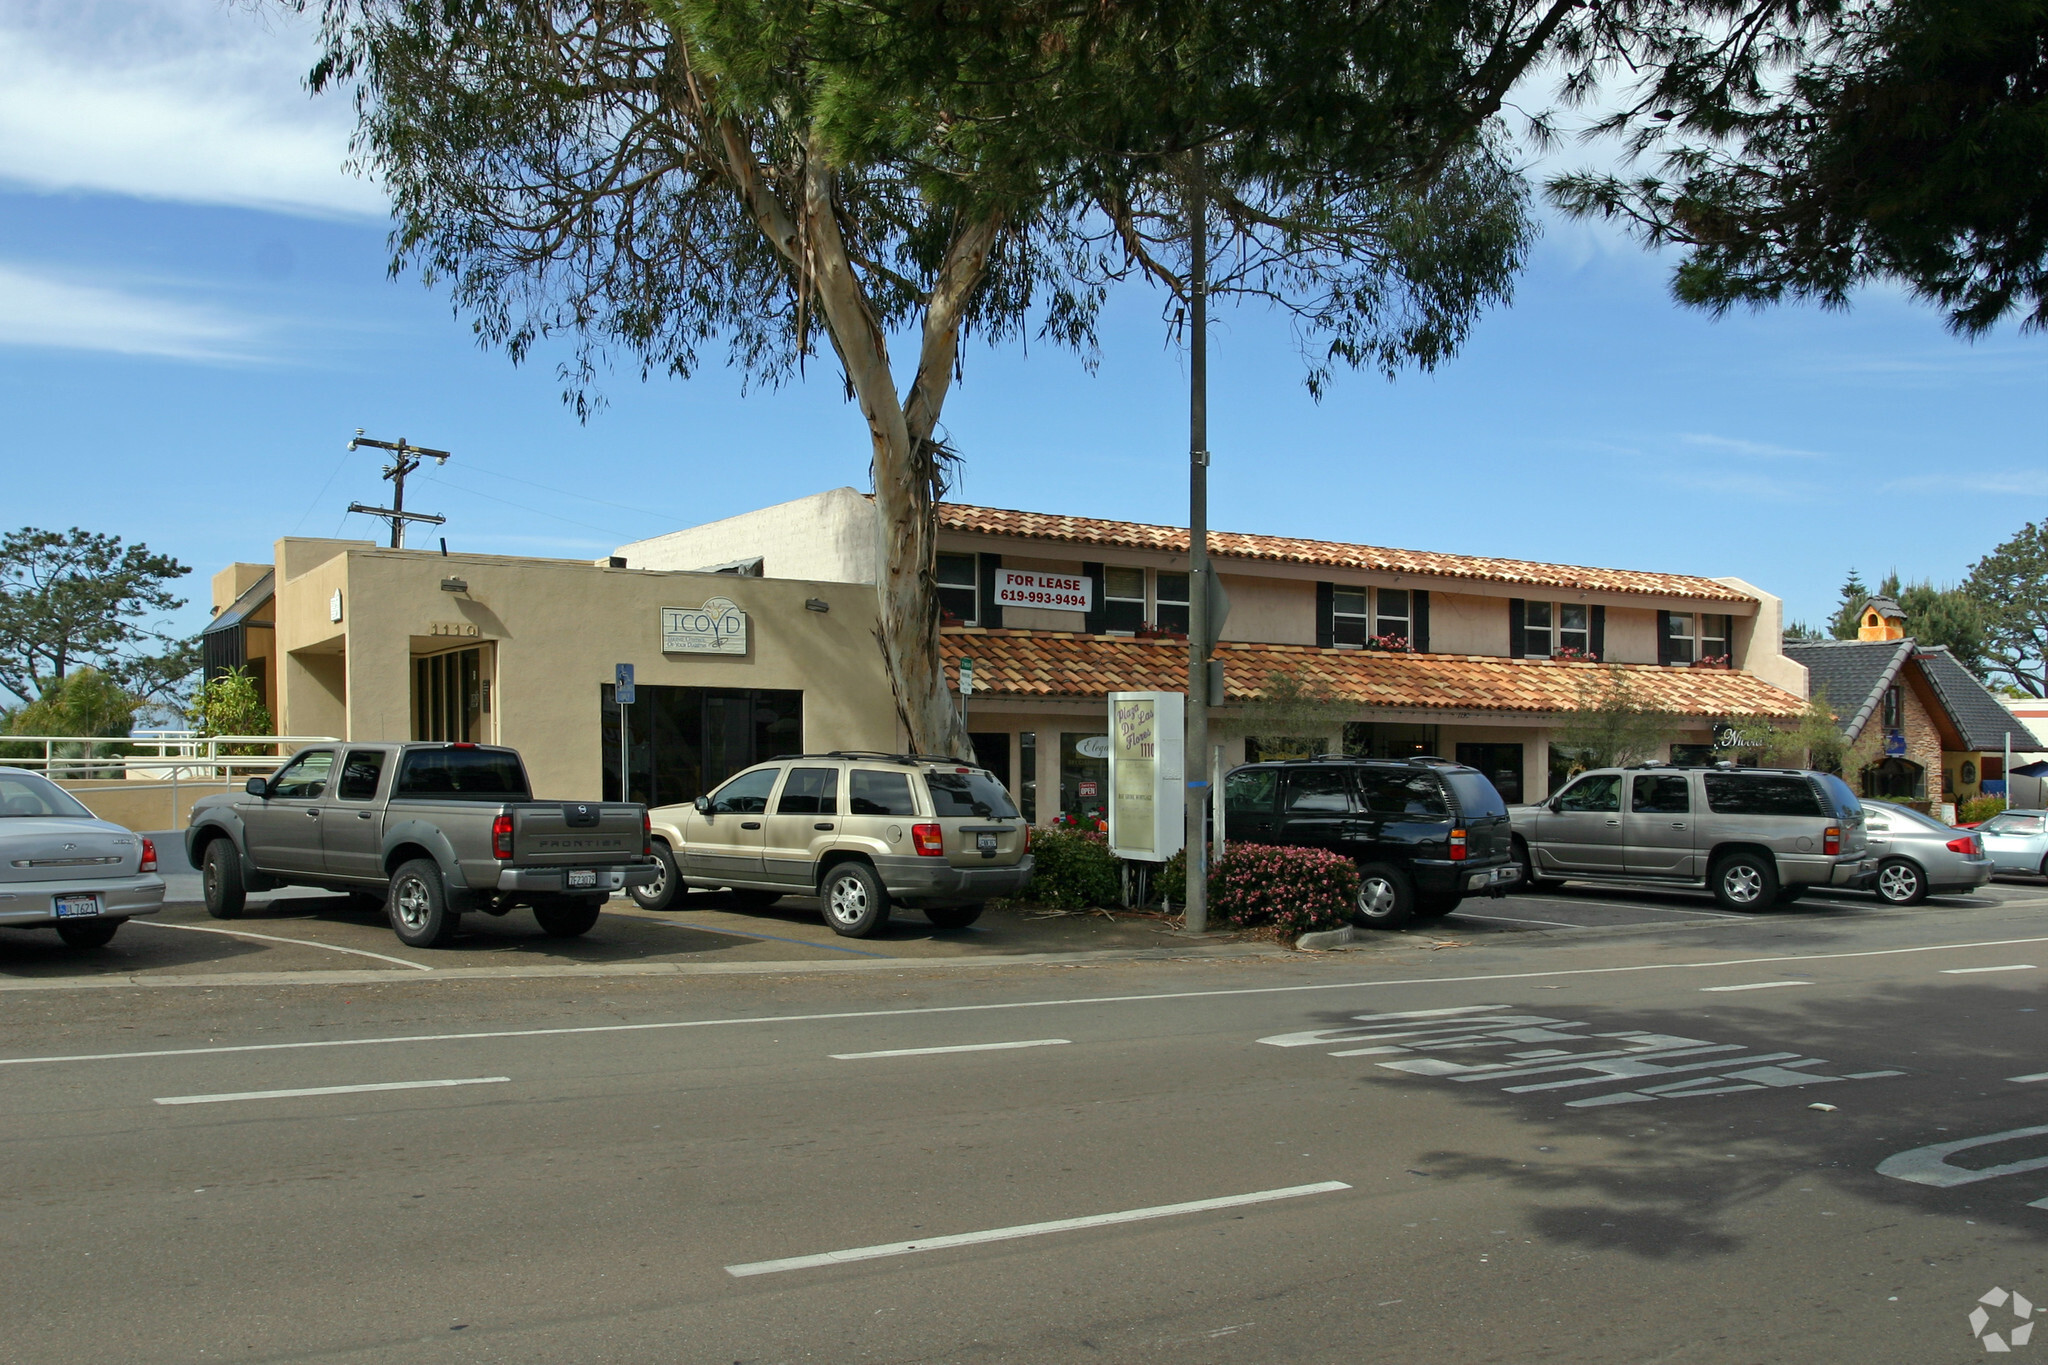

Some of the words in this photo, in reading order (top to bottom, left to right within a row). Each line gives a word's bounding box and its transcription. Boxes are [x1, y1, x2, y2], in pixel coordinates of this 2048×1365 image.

[1007, 574, 1034, 587] FOR
[1038, 577, 1081, 591] LEASE
[1001, 589, 1086, 606] 619-993-9494
[431, 623, 477, 637] 1110
[669, 606, 741, 643] TCOYD
[1117, 704, 1139, 723] Plaza
[1122, 722, 1135, 736] De
[1138, 710, 1154, 726] Las
[1126, 729, 1152, 751] Flores
[538, 839, 623, 848] FRONTIER
